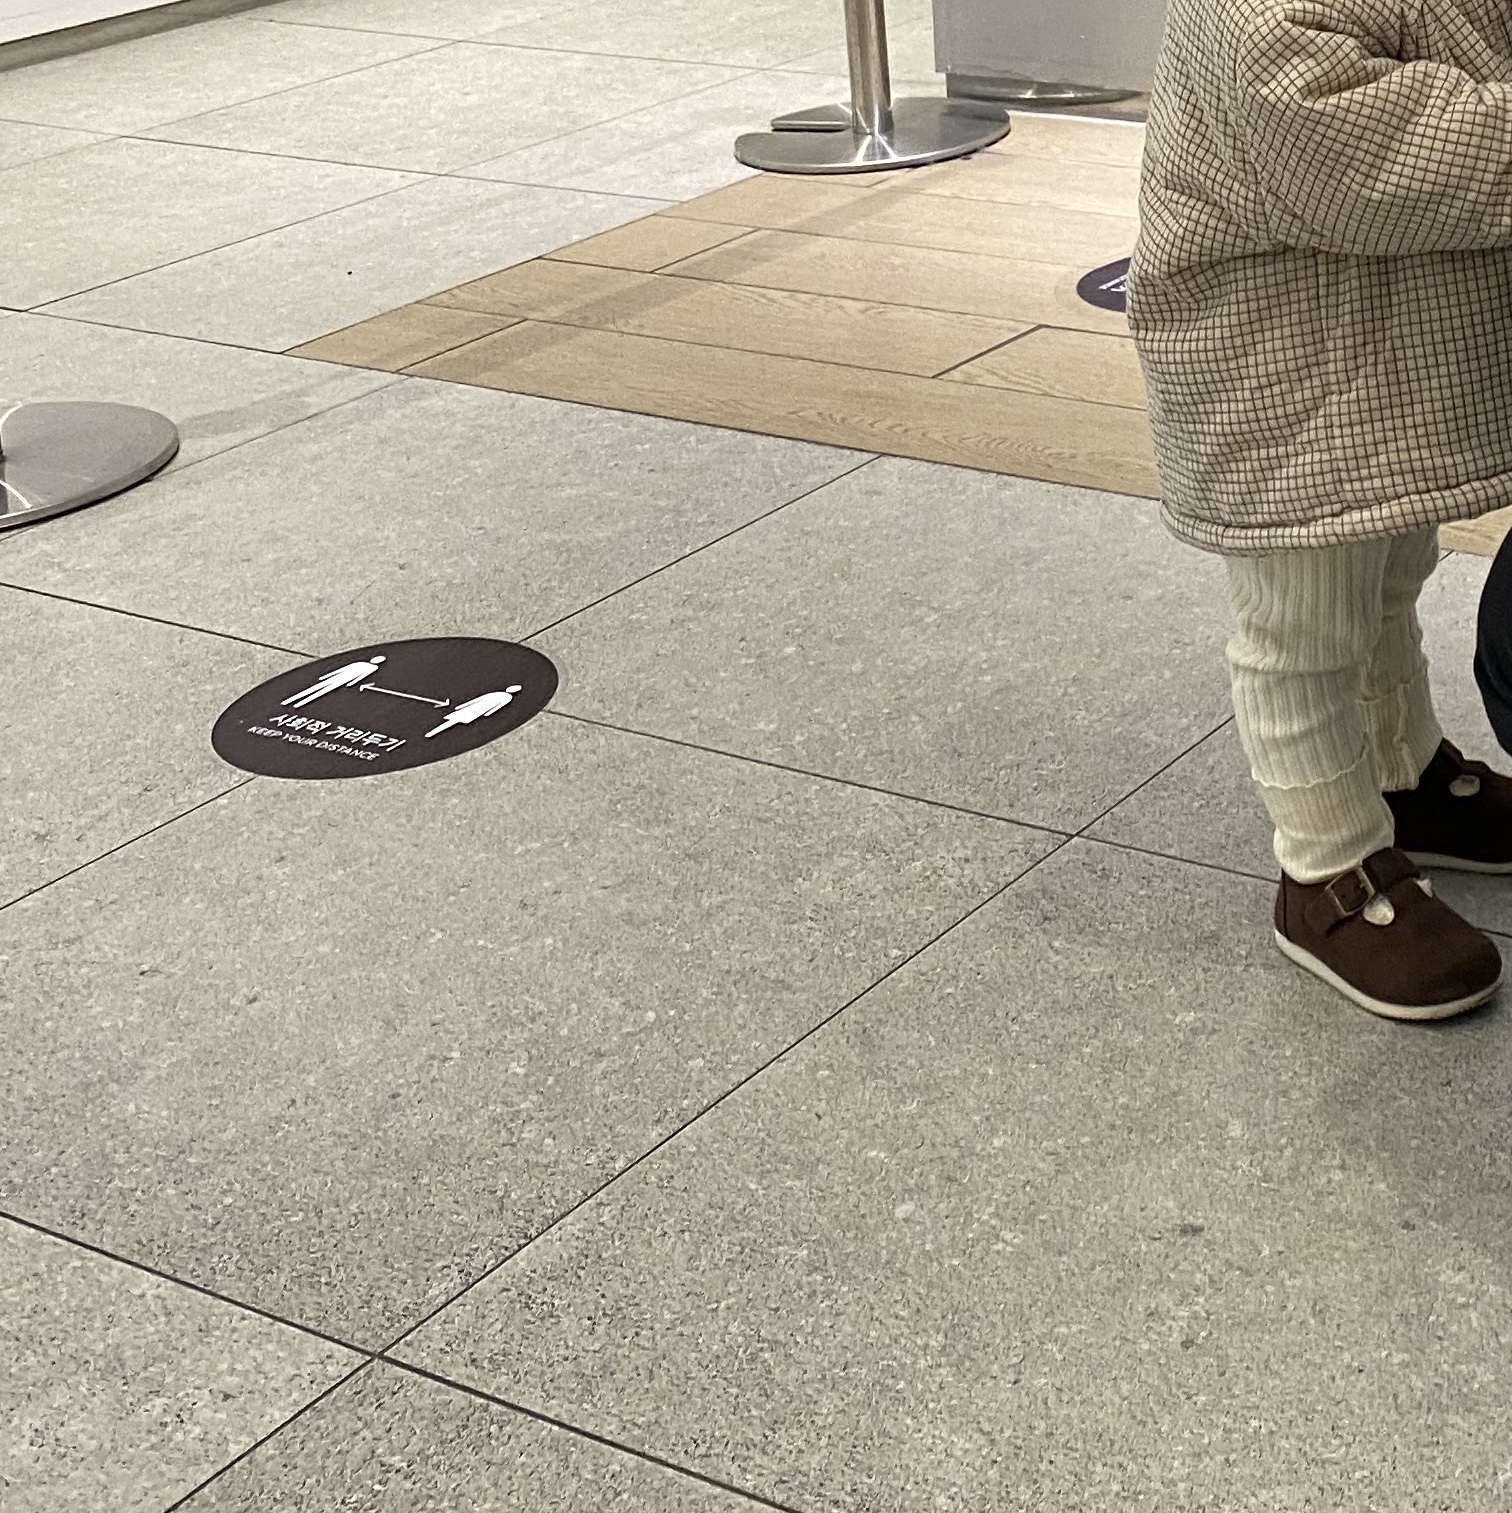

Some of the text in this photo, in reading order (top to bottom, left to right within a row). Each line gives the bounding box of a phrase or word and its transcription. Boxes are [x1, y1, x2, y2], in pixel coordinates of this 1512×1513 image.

[247, 726, 381, 762] KEEP YOUR DISTANCE
[269, 713, 407, 752] 사회적 거리두기
